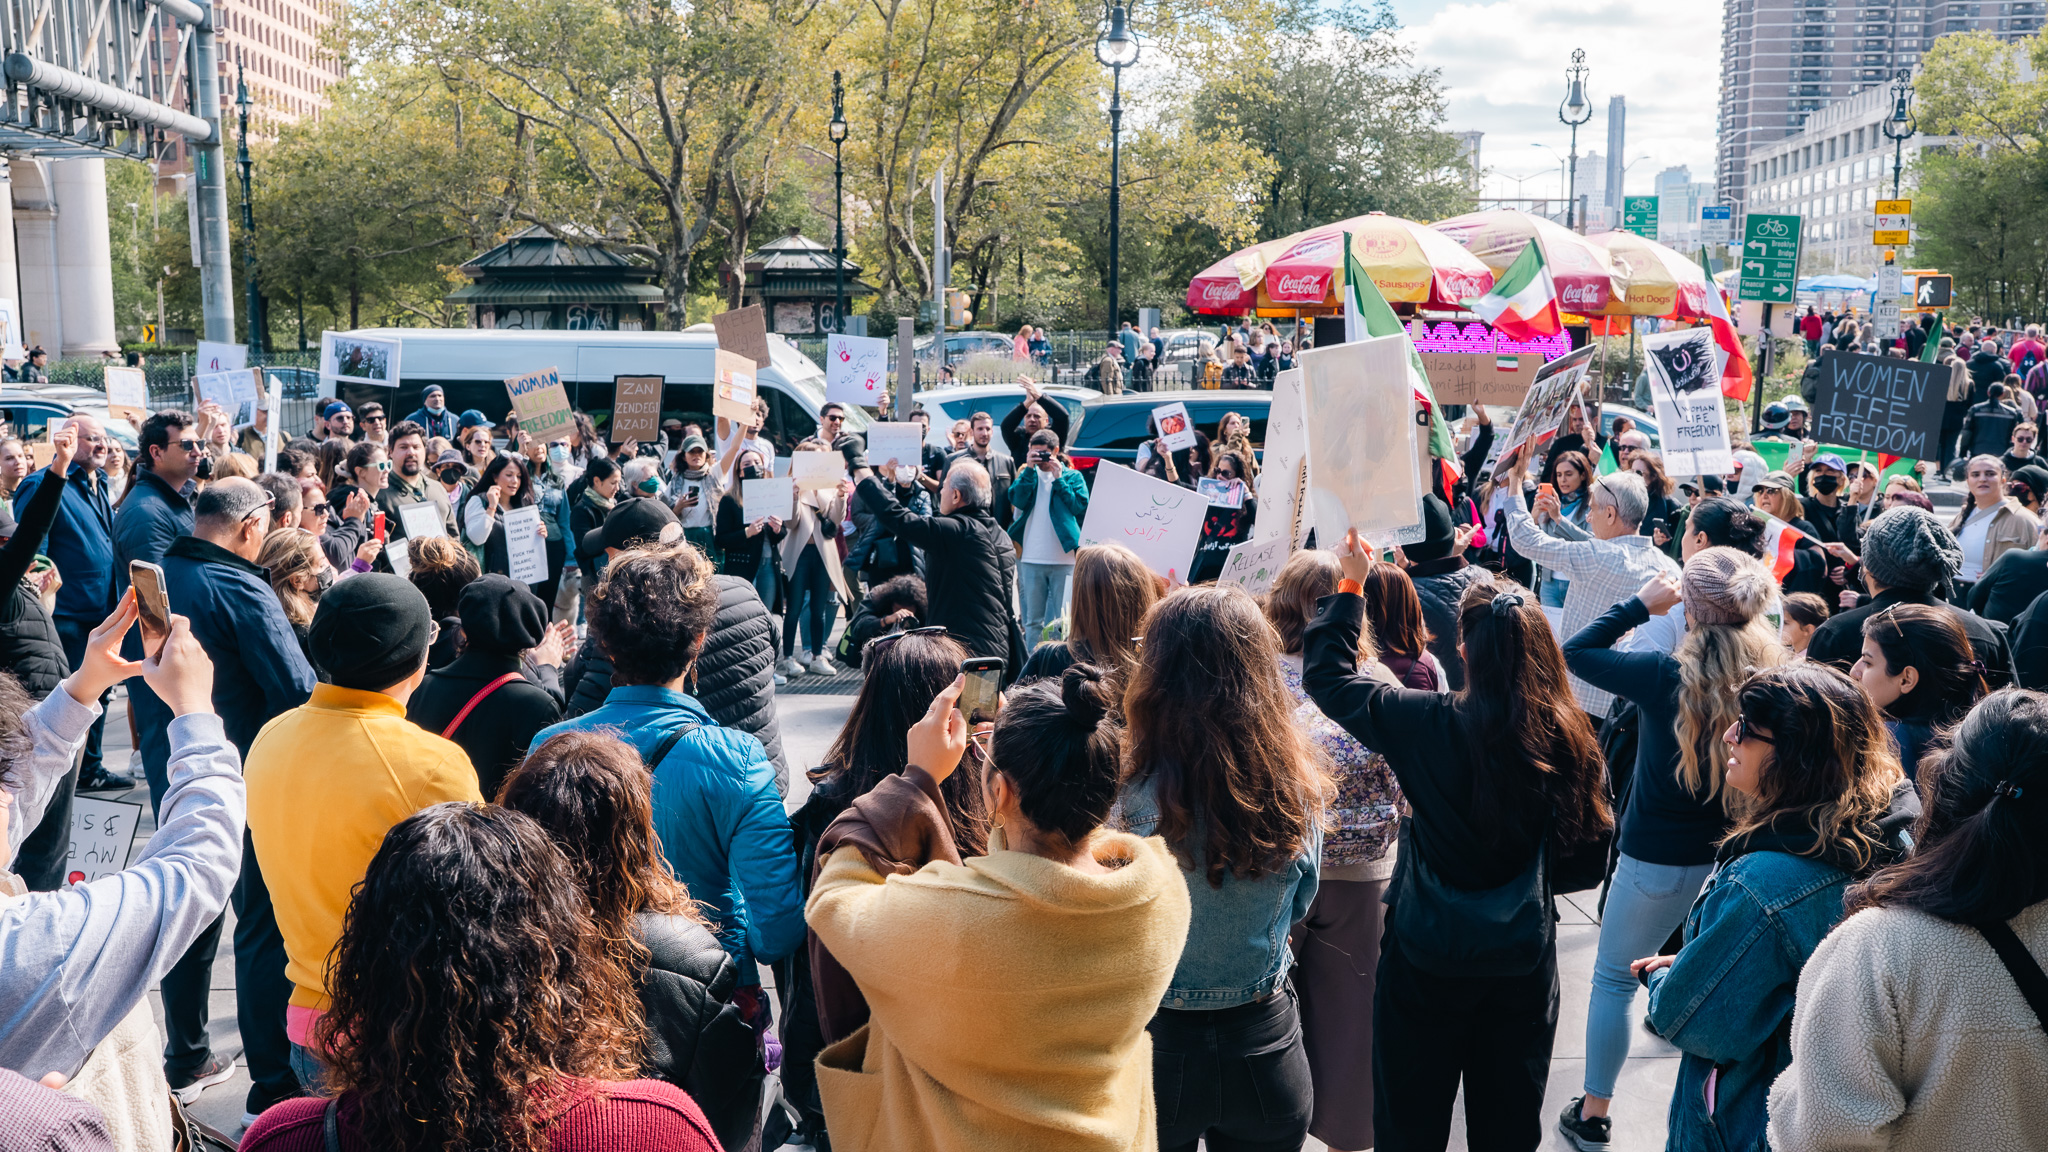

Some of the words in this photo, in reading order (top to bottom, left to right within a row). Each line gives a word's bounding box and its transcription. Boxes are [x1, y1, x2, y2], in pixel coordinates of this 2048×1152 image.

[1771, 240, 1796, 249] Brooklyn
[1778, 249, 1795, 259] Bridge
[1773, 270, 1791, 278] Square
[1379, 280, 1425, 290] Sausages
[1742, 280, 1765, 288] Financial
[1629, 294, 1644, 303] Hot
[1650, 294, 1670, 304] Dogs
[1741, 289, 1760, 297] District
[1880, 308, 1898, 316] KEEP
[719, 308, 758, 331] KEEP
[508, 371, 559, 397] WOMAN
[1833, 358, 1930, 403] WOMEN
[622, 382, 654, 395] ZAN
[519, 390, 560, 415] LIFE
[615, 401, 659, 414] ZENDEGI
[1830, 391, 1910, 428] LIFE
[519, 407, 573, 435] FREEDOM
[615, 418, 653, 430] AZADI
[1677, 424, 1721, 438] FREEDOM
[1818, 414, 1926, 459] FREEDOM
[511, 534, 530, 542] TEHRAN
[1228, 545, 1276, 576] RELEASE
[514, 565, 536, 573] REPUBLIC
